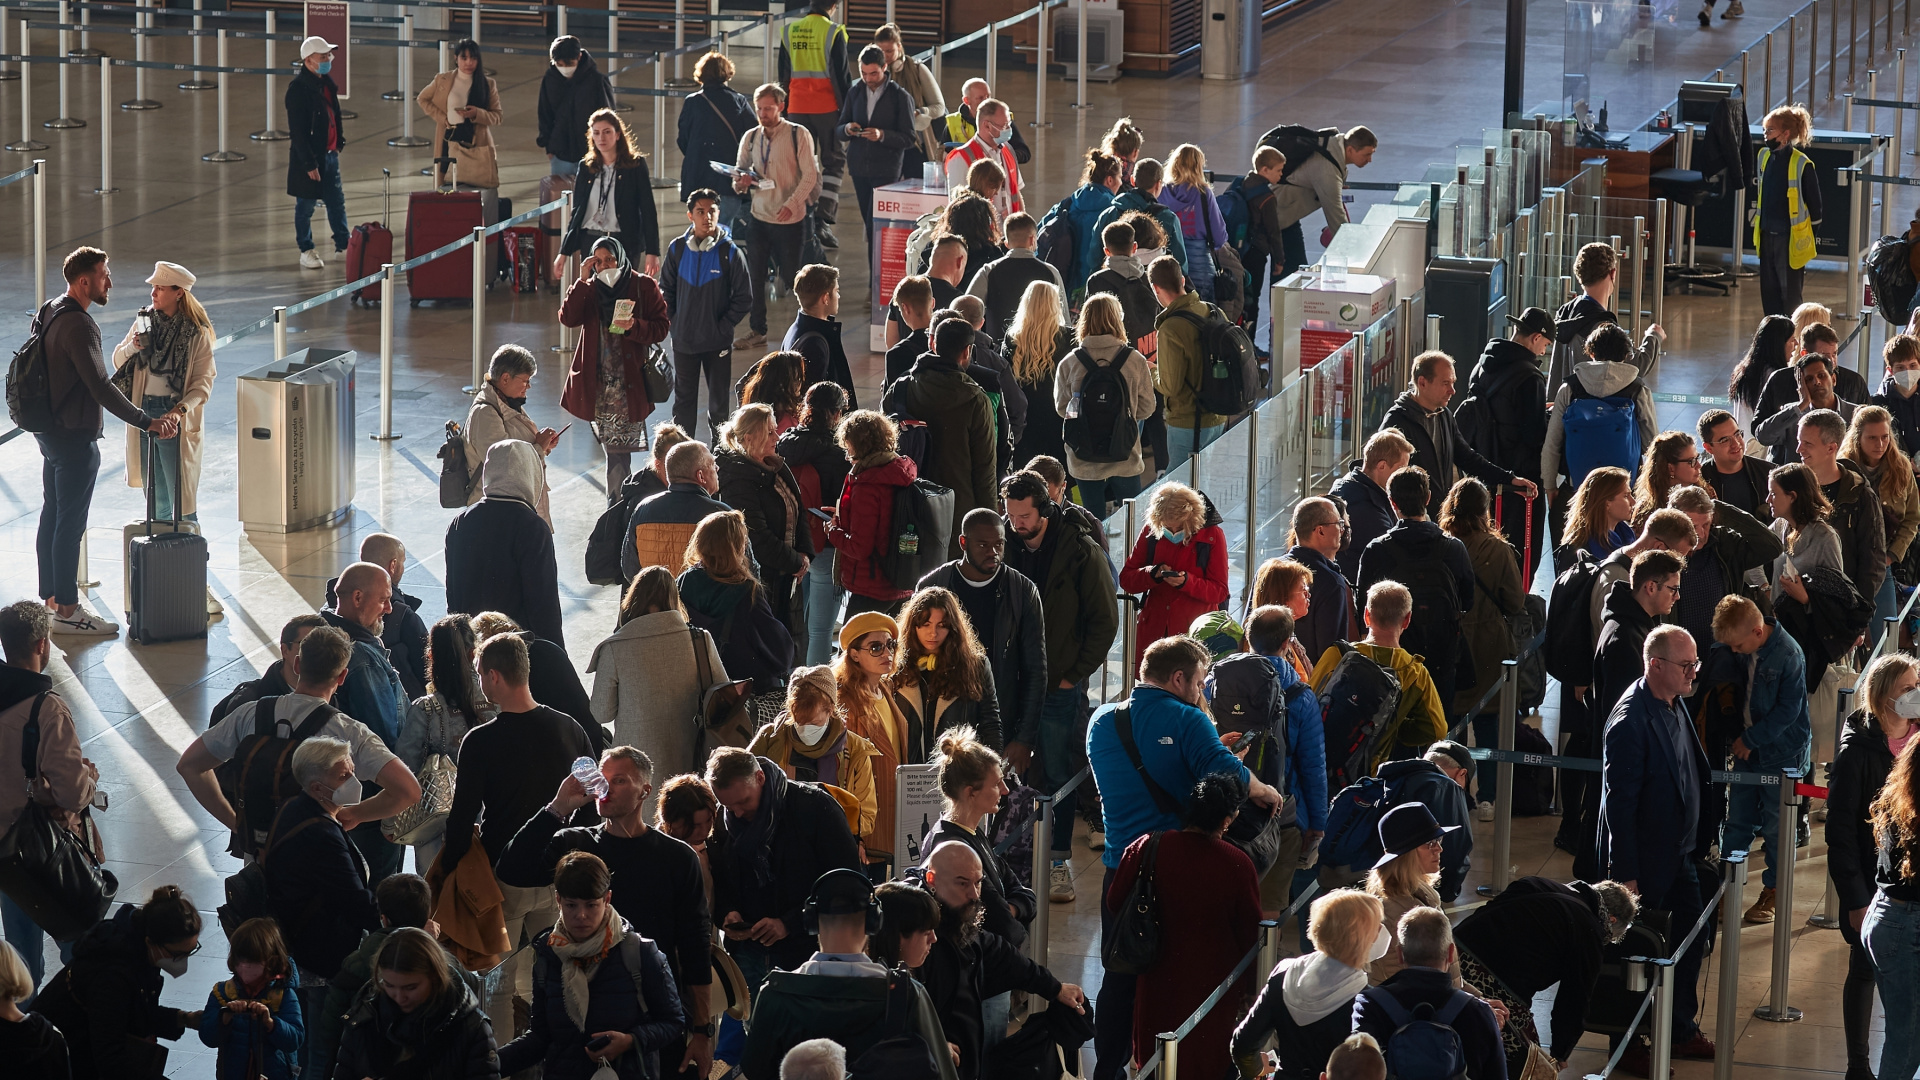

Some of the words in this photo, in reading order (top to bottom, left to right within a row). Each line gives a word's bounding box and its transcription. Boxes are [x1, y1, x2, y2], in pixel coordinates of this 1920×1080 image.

[878, 201, 900, 212] BER
[1524, 754, 1542, 764] BER
[1761, 776, 1779, 784] BER
